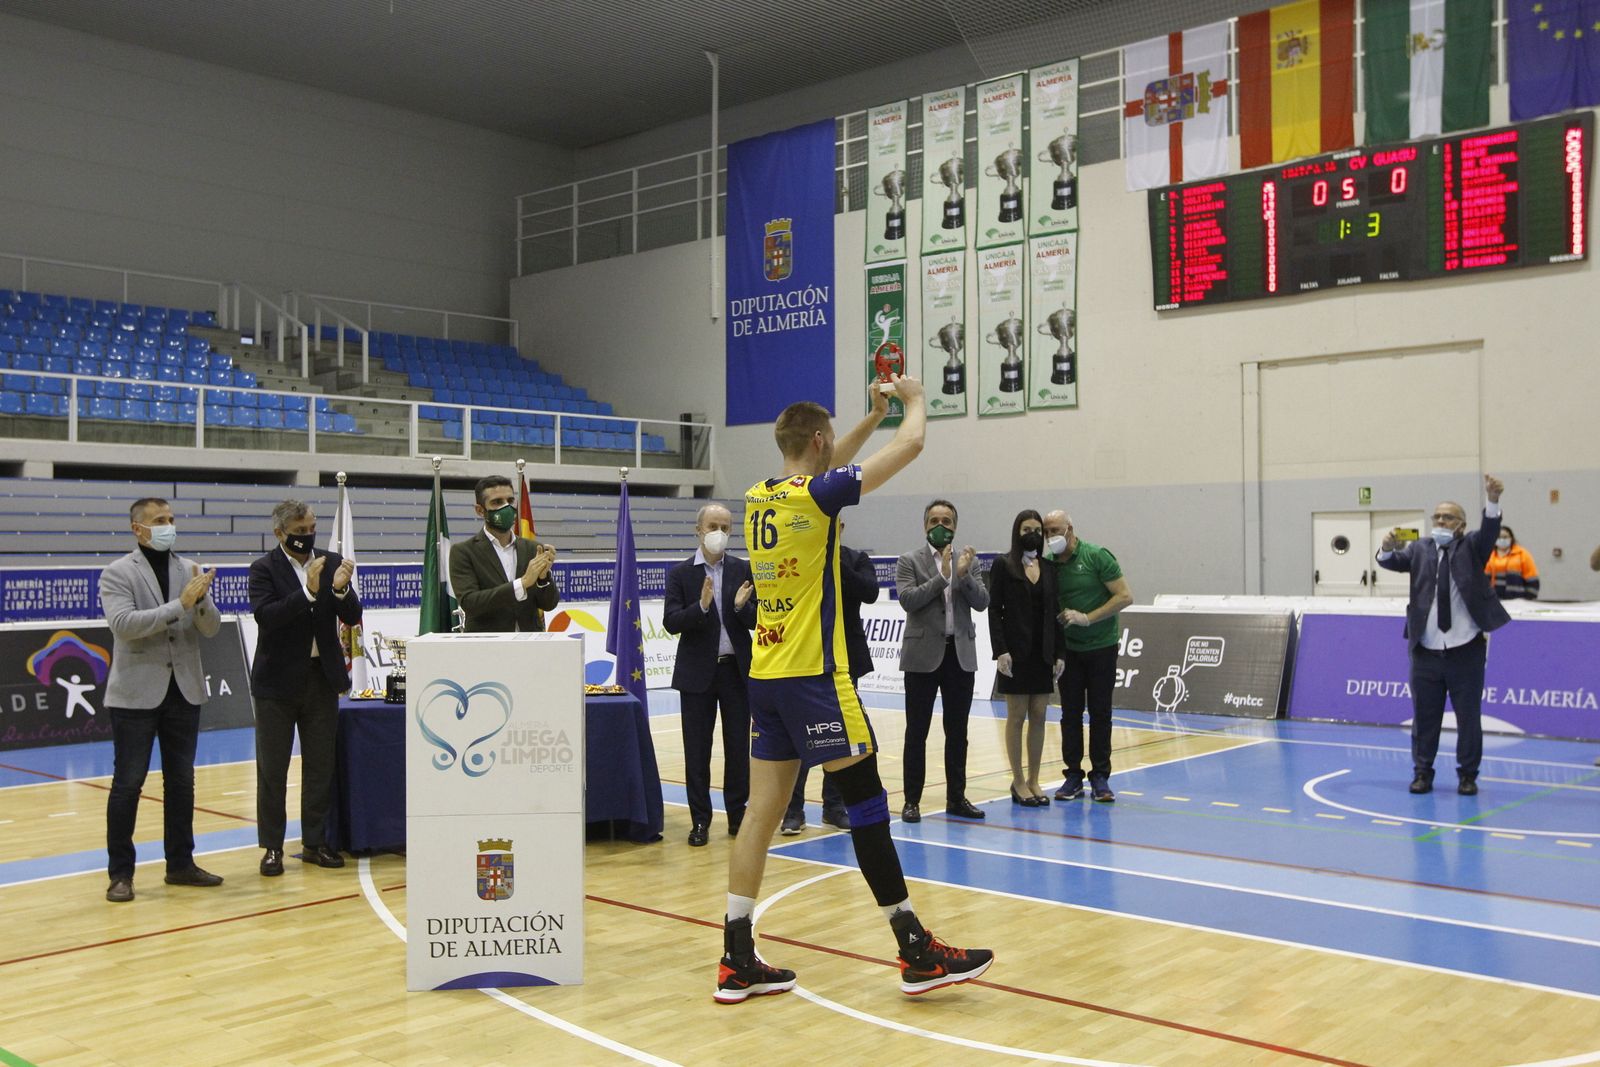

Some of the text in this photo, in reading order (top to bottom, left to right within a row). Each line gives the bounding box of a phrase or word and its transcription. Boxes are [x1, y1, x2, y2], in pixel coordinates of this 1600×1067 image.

[1390, 167, 1407, 194] 0
[1312, 177, 1355, 207] 0 5
[731, 284, 829, 317] DIPUTACIÓN
[733, 305, 827, 337] DE ALMERÍA
[750, 509, 778, 551] 16
[756, 561, 775, 570] Islas
[5, 577, 44, 590] ALMERÍA
[396, 571, 422, 581] ALMERÍA
[396, 581, 422, 590] JUEGA
[570, 585, 592, 593] LIMPIO
[5, 590, 44, 600] JUEGA
[396, 590, 422, 599] LIMPIO
[4, 600, 44, 610] LIMPIO
[1223, 692, 1264, 708] #qntcc
[1502, 687, 1599, 710] ALMERÍA
[806, 721, 843, 735] HPS
[501, 729, 571, 747] JUEGA
[500, 747, 573, 765] LIMPIO
[529, 764, 575, 773] DEPORTE
[426, 910, 565, 936] DIPUTACIÓN
[429, 933, 562, 958] DE ALMERÍA
